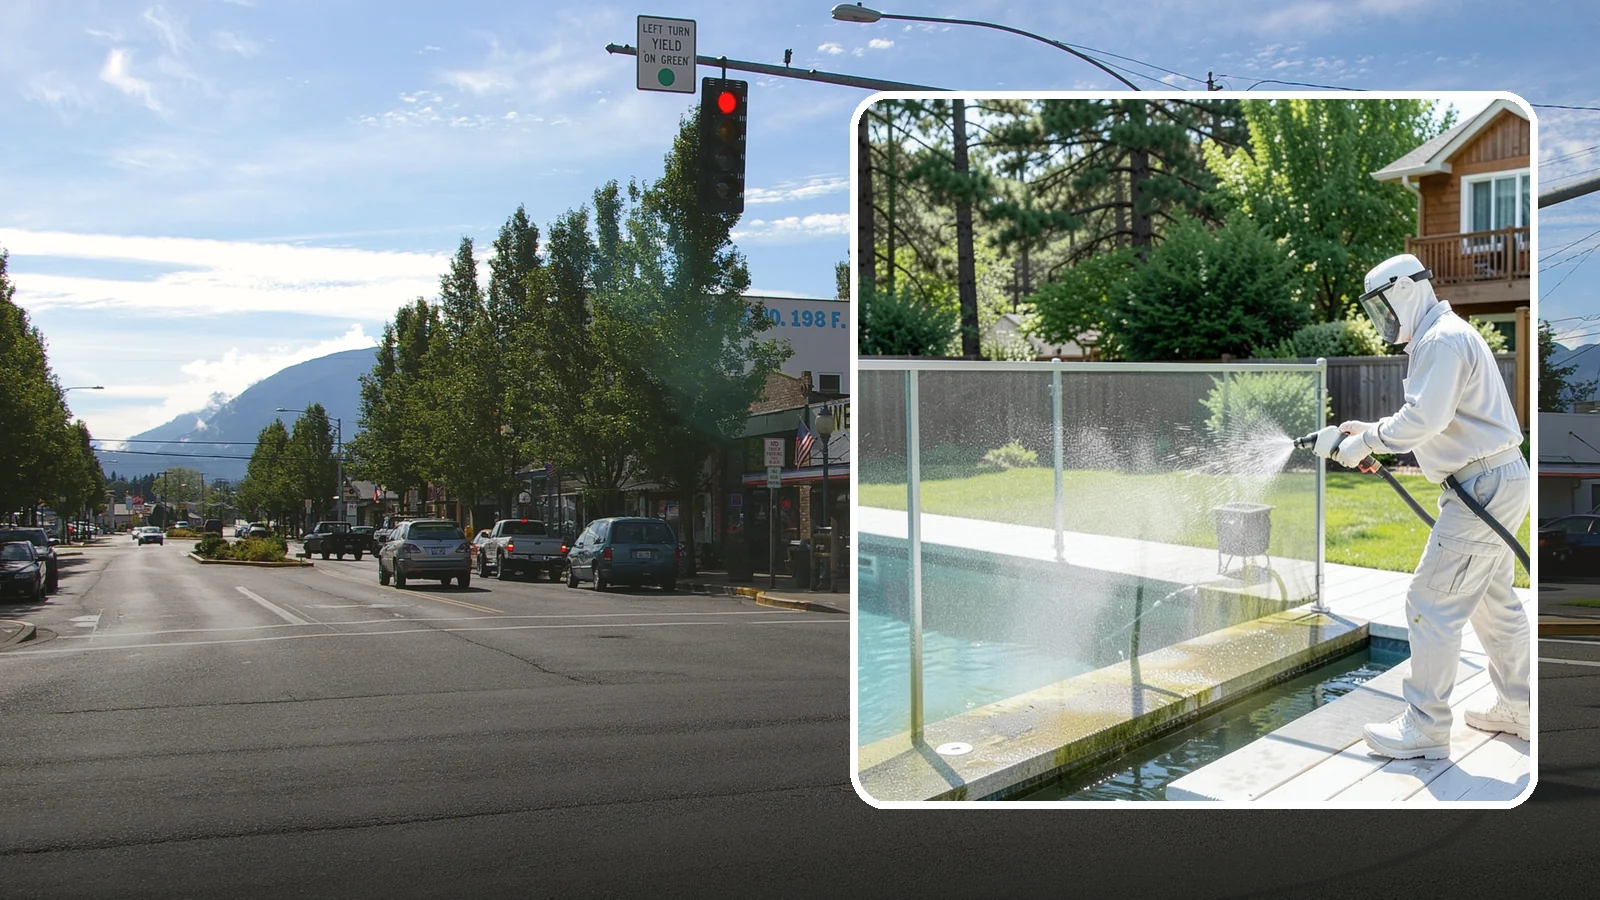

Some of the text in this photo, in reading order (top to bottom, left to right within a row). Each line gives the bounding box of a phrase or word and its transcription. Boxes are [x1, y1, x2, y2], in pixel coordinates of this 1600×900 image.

[643, 23, 690, 37] LEFT TURN
[652, 38, 682, 51] YIELD
[644, 53, 688, 66] ON GREEN
[791, 310, 826, 327] 198
[831, 311, 846, 329] F.
